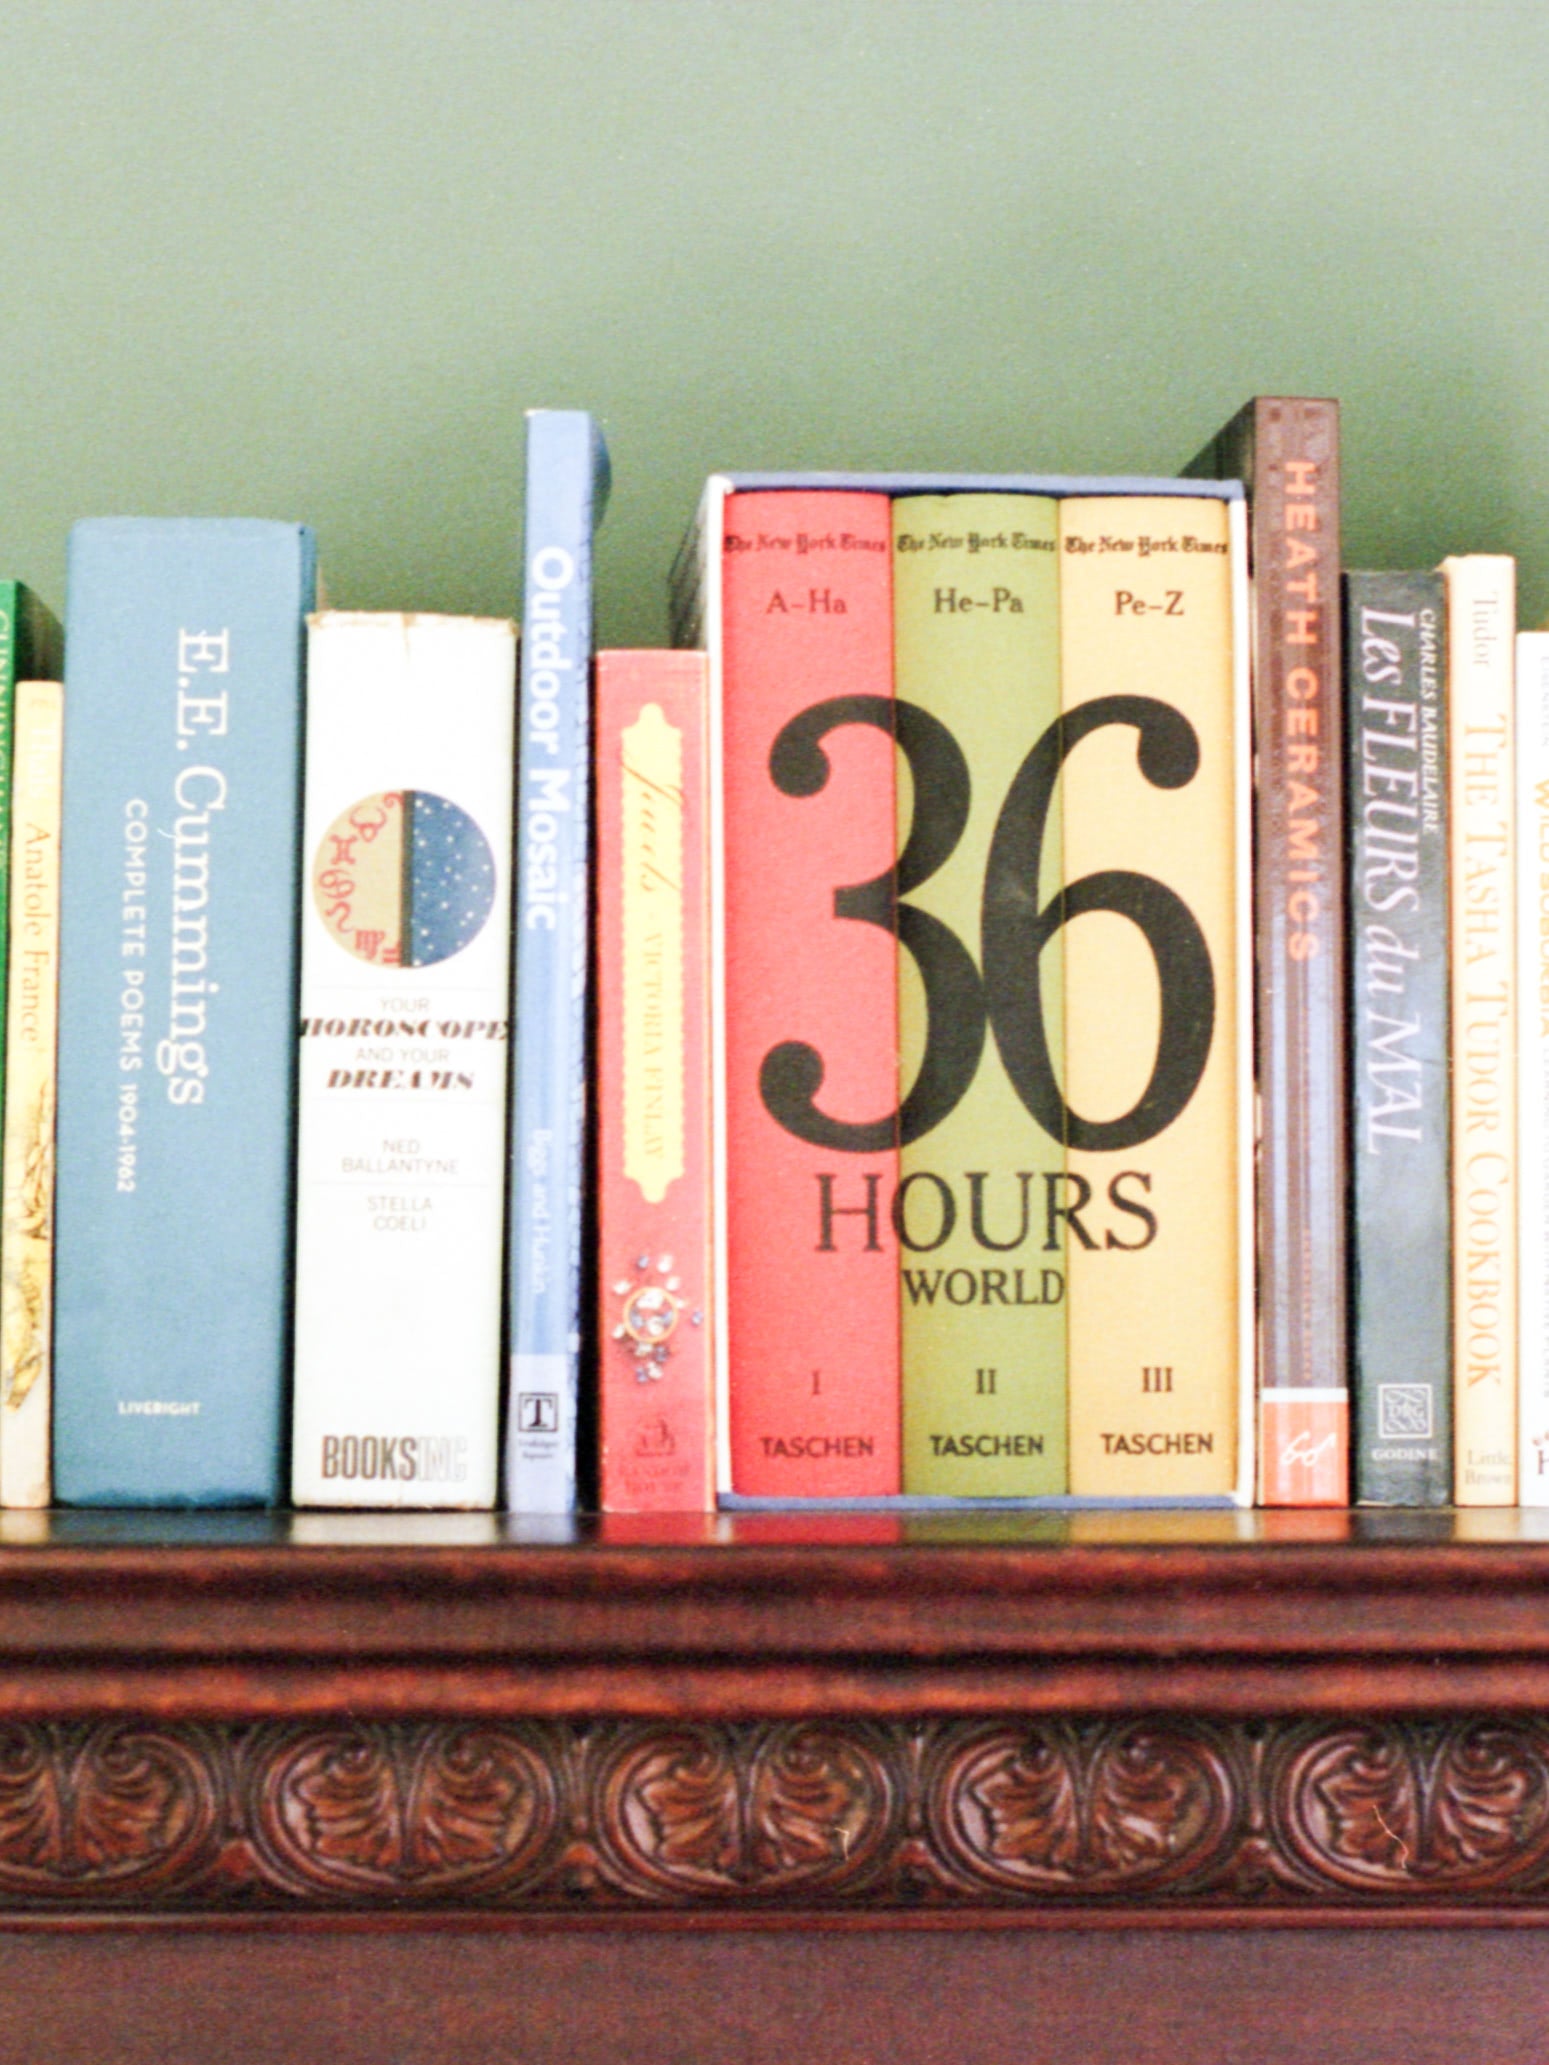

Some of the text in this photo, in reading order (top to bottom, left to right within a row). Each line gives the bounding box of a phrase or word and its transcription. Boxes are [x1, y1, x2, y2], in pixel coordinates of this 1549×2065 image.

[726, 532, 886, 555] The New York Times
[898, 532, 1056, 555] The New York Times
[1065, 535, 1228, 557] The New York Times
[1473, 592, 1498, 667] Tudor
[1283, 460, 1322, 963] HEATH CERAMICS
[1419, 608, 1440, 834] CHARLES BAUDELAIRE
[526, 546, 574, 931] Outdoor Mosaic
[1360, 606, 1424, 1155] Les FLEURS du MAL
[21, 822, 51, 1042] Anatole France
[156, 766, 227, 1105] Cummings
[758, 693, 1216, 1153] 36
[116, 799, 148, 1192] COMPLETE POEMS 1904-1962
[379, 997, 430, 1012] YOUR
[301, 1018, 509, 1040] HOROSCOPE
[355, 1048, 450, 1063] AND YOUR
[1464, 713, 1511, 1388] THE TASHA TUDOR COOKBOOK
[327, 1069, 475, 1090] DREAMS
[382, 1139, 420, 1154] NED
[341, 1158, 459, 1174] BALLANTYNE
[368, 1197, 433, 1212] STELLA
[816, 1171, 1158, 1252] HOURS
[901, 1269, 1065, 1305] WORLD
[811, 1371, 821, 1396] I
[975, 1369, 997, 1395] II
[1142, 1367, 1173, 1394] III
[119, 1401, 200, 1415] LIVERIGHT
[760, 1436, 874, 1457] TASCHEN
[930, 1435, 1044, 1456] TASCHEN
[1102, 1433, 1214, 1454] TASCHEN
